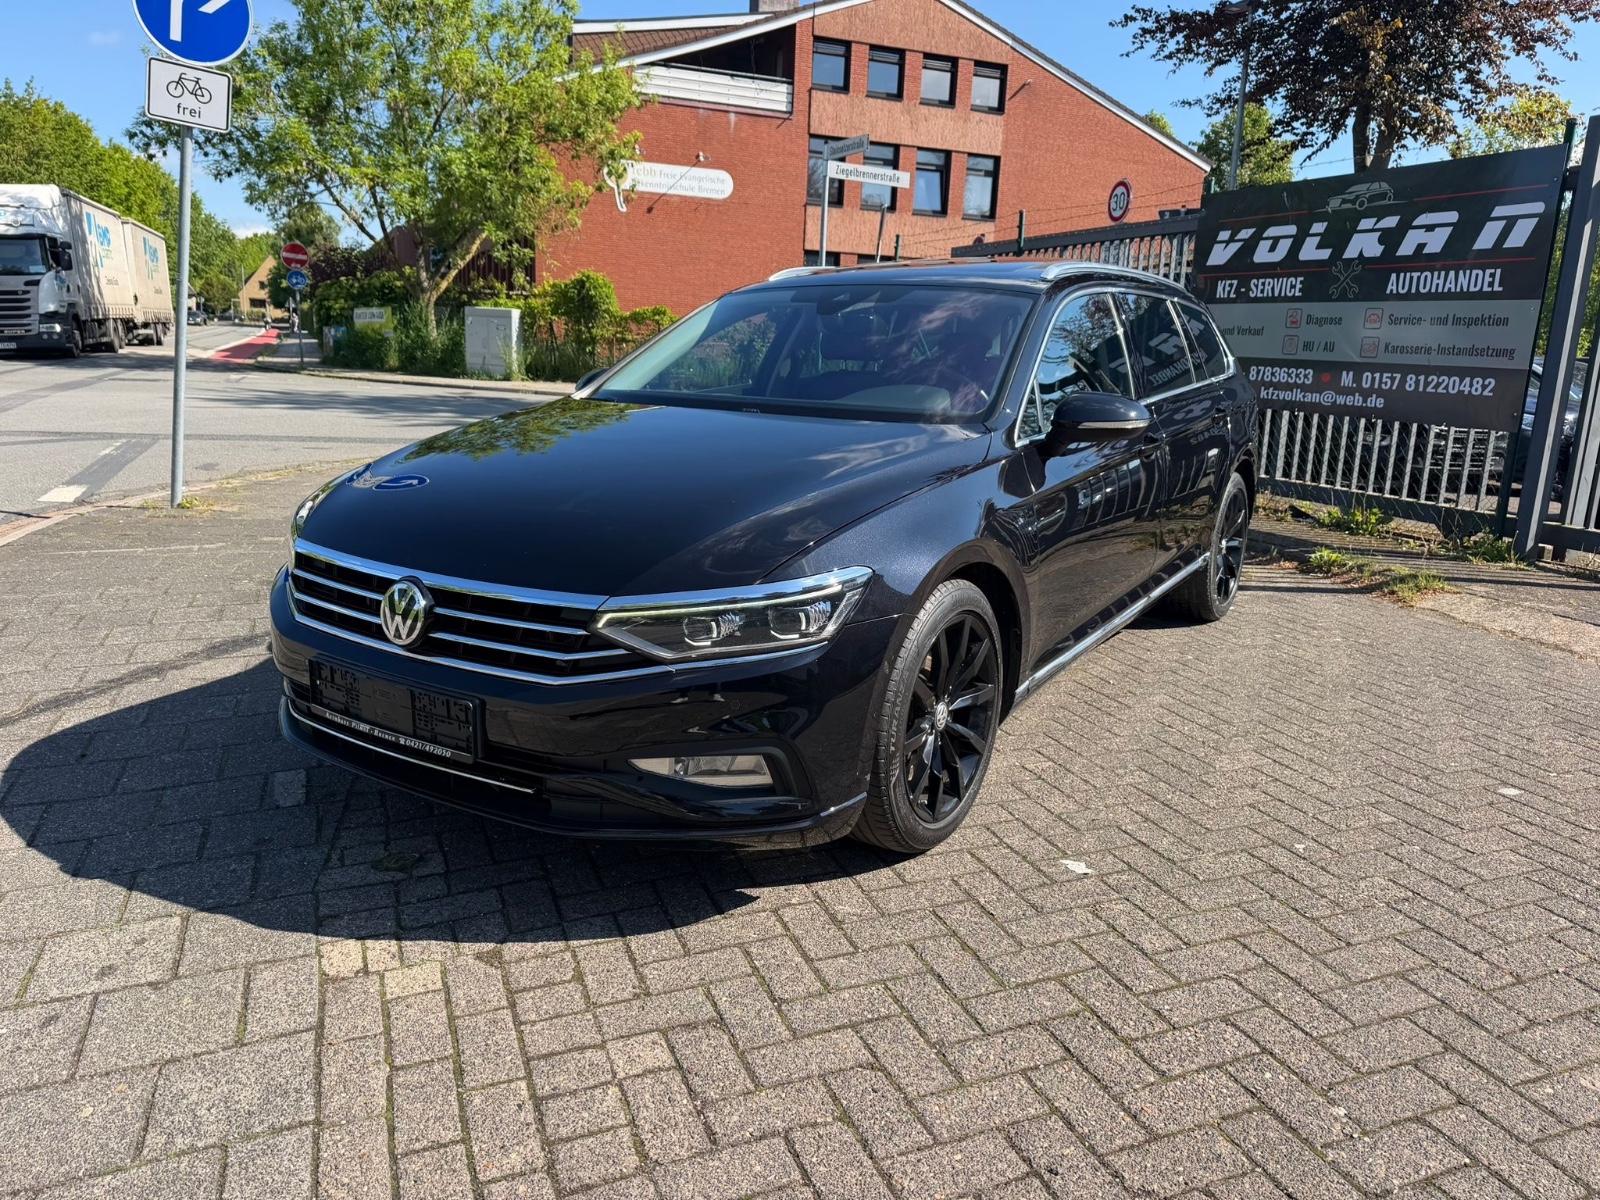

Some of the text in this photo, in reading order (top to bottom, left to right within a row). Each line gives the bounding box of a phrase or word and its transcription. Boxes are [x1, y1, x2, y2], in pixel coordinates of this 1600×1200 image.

[177, 103, 201, 119] frei
[835, 164, 901, 184] Ziegelbrennerstraße
[1111, 191, 1126, 212] 30
[1206, 202, 1546, 266] VOLKAN
[1216, 279, 1239, 299] KFZ
[1249, 277, 1304, 298] SERVICE
[1386, 269, 1503, 294] AUTOHANDEL
[1306, 313, 1343, 327] Diagnose
[1430, 313, 1449, 327] und
[1451, 313, 1510, 329] Inspektion
[1236, 325, 1265, 336] Verkauf
[1302, 341, 1315, 352] HU
[1323, 341, 1336, 353] AU
[1384, 342, 1516, 361] Karosserie-Instandsetzung
[1249, 366, 1496, 397] 87836333 M. 0157 81220482
[1260, 386, 1385, 408] kfzvolkan@web.de
